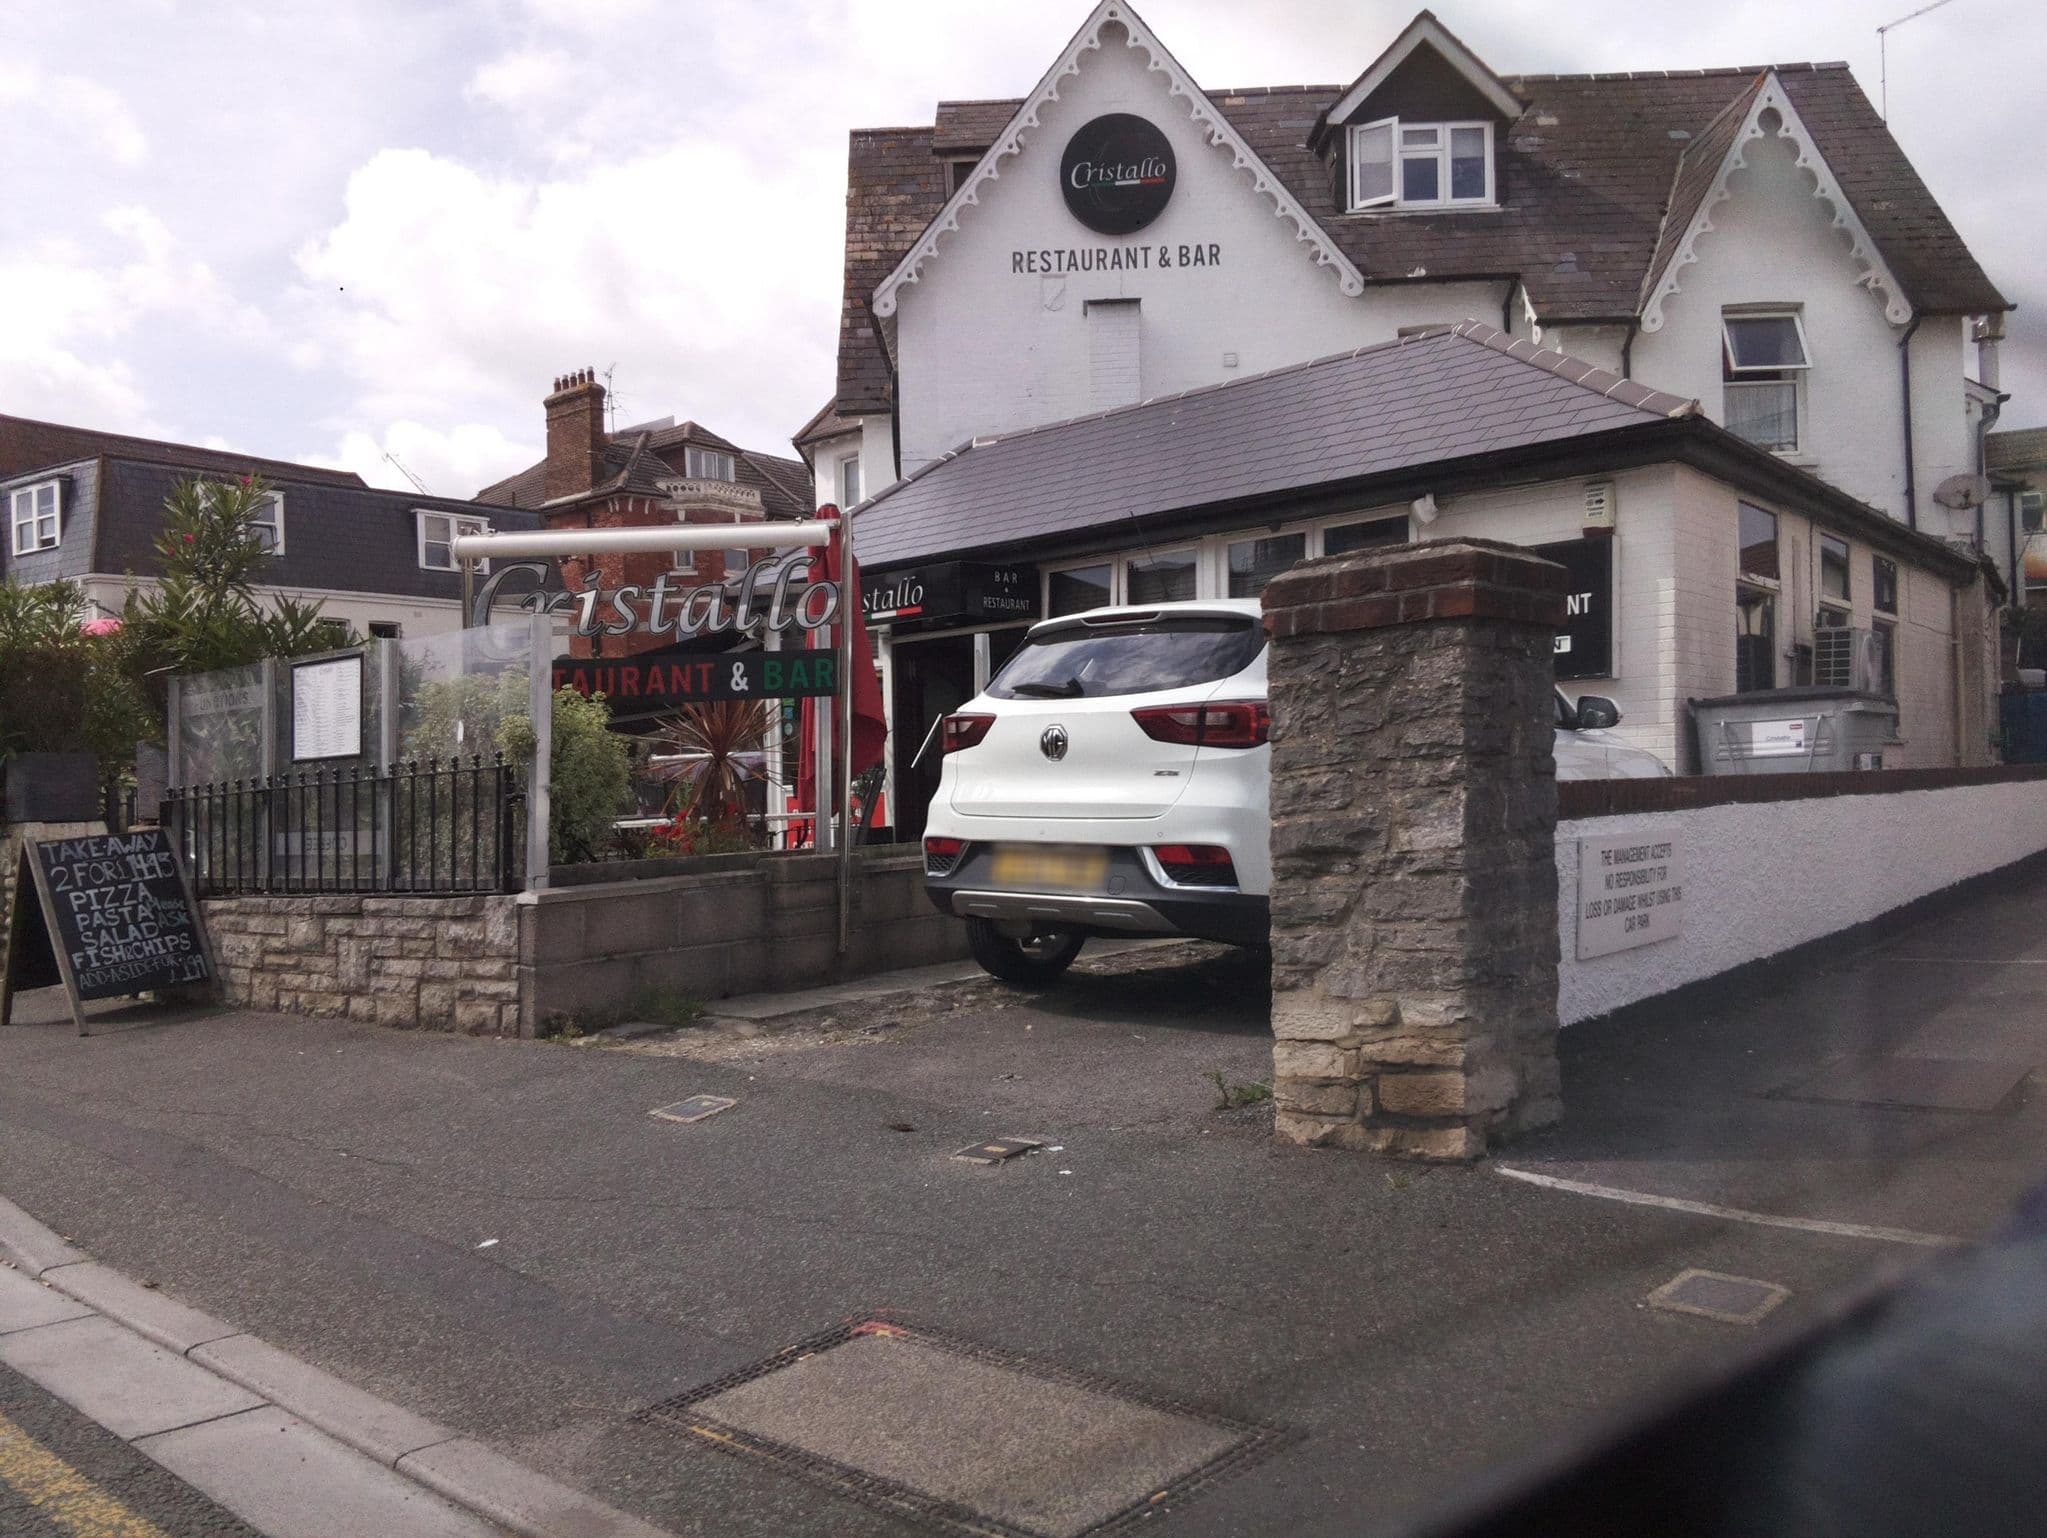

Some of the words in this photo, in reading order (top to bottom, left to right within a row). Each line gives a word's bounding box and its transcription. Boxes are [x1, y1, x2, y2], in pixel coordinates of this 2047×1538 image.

[1071, 156, 1167, 189] Cristallo
[1012, 246, 1151, 274] RESTAURANT
[1158, 245, 1171, 268] &
[1178, 243, 1221, 267] BAR
[994, 571, 1018, 584] BAR
[472, 554, 840, 660] Cristallo
[983, 595, 1030, 611] RESTAURANT
[730, 661, 749, 693] &
[763, 658, 834, 690] BAR
[1601, 849, 1612, 866] THE
[1614, 846, 1650, 864] MANAGEMENT
[50, 867, 74, 892] 2
[73, 861, 118, 886] FOR
[1605, 873, 1614, 890] NO
[1615, 867, 1656, 888] RESPONSIBILITY
[1657, 866, 1667, 881] FOR
[69, 882, 153, 912] PIZZA
[1585, 899, 1602, 920] LOSS
[1603, 899, 1612, 916] OR
[1614, 895, 1637, 914] DAMAGE
[75, 904, 154, 932] PASTA
[1625, 915, 1636, 933] CAR
[1637, 913, 1649, 930] PARK
[81, 922, 159, 950] SALAD
